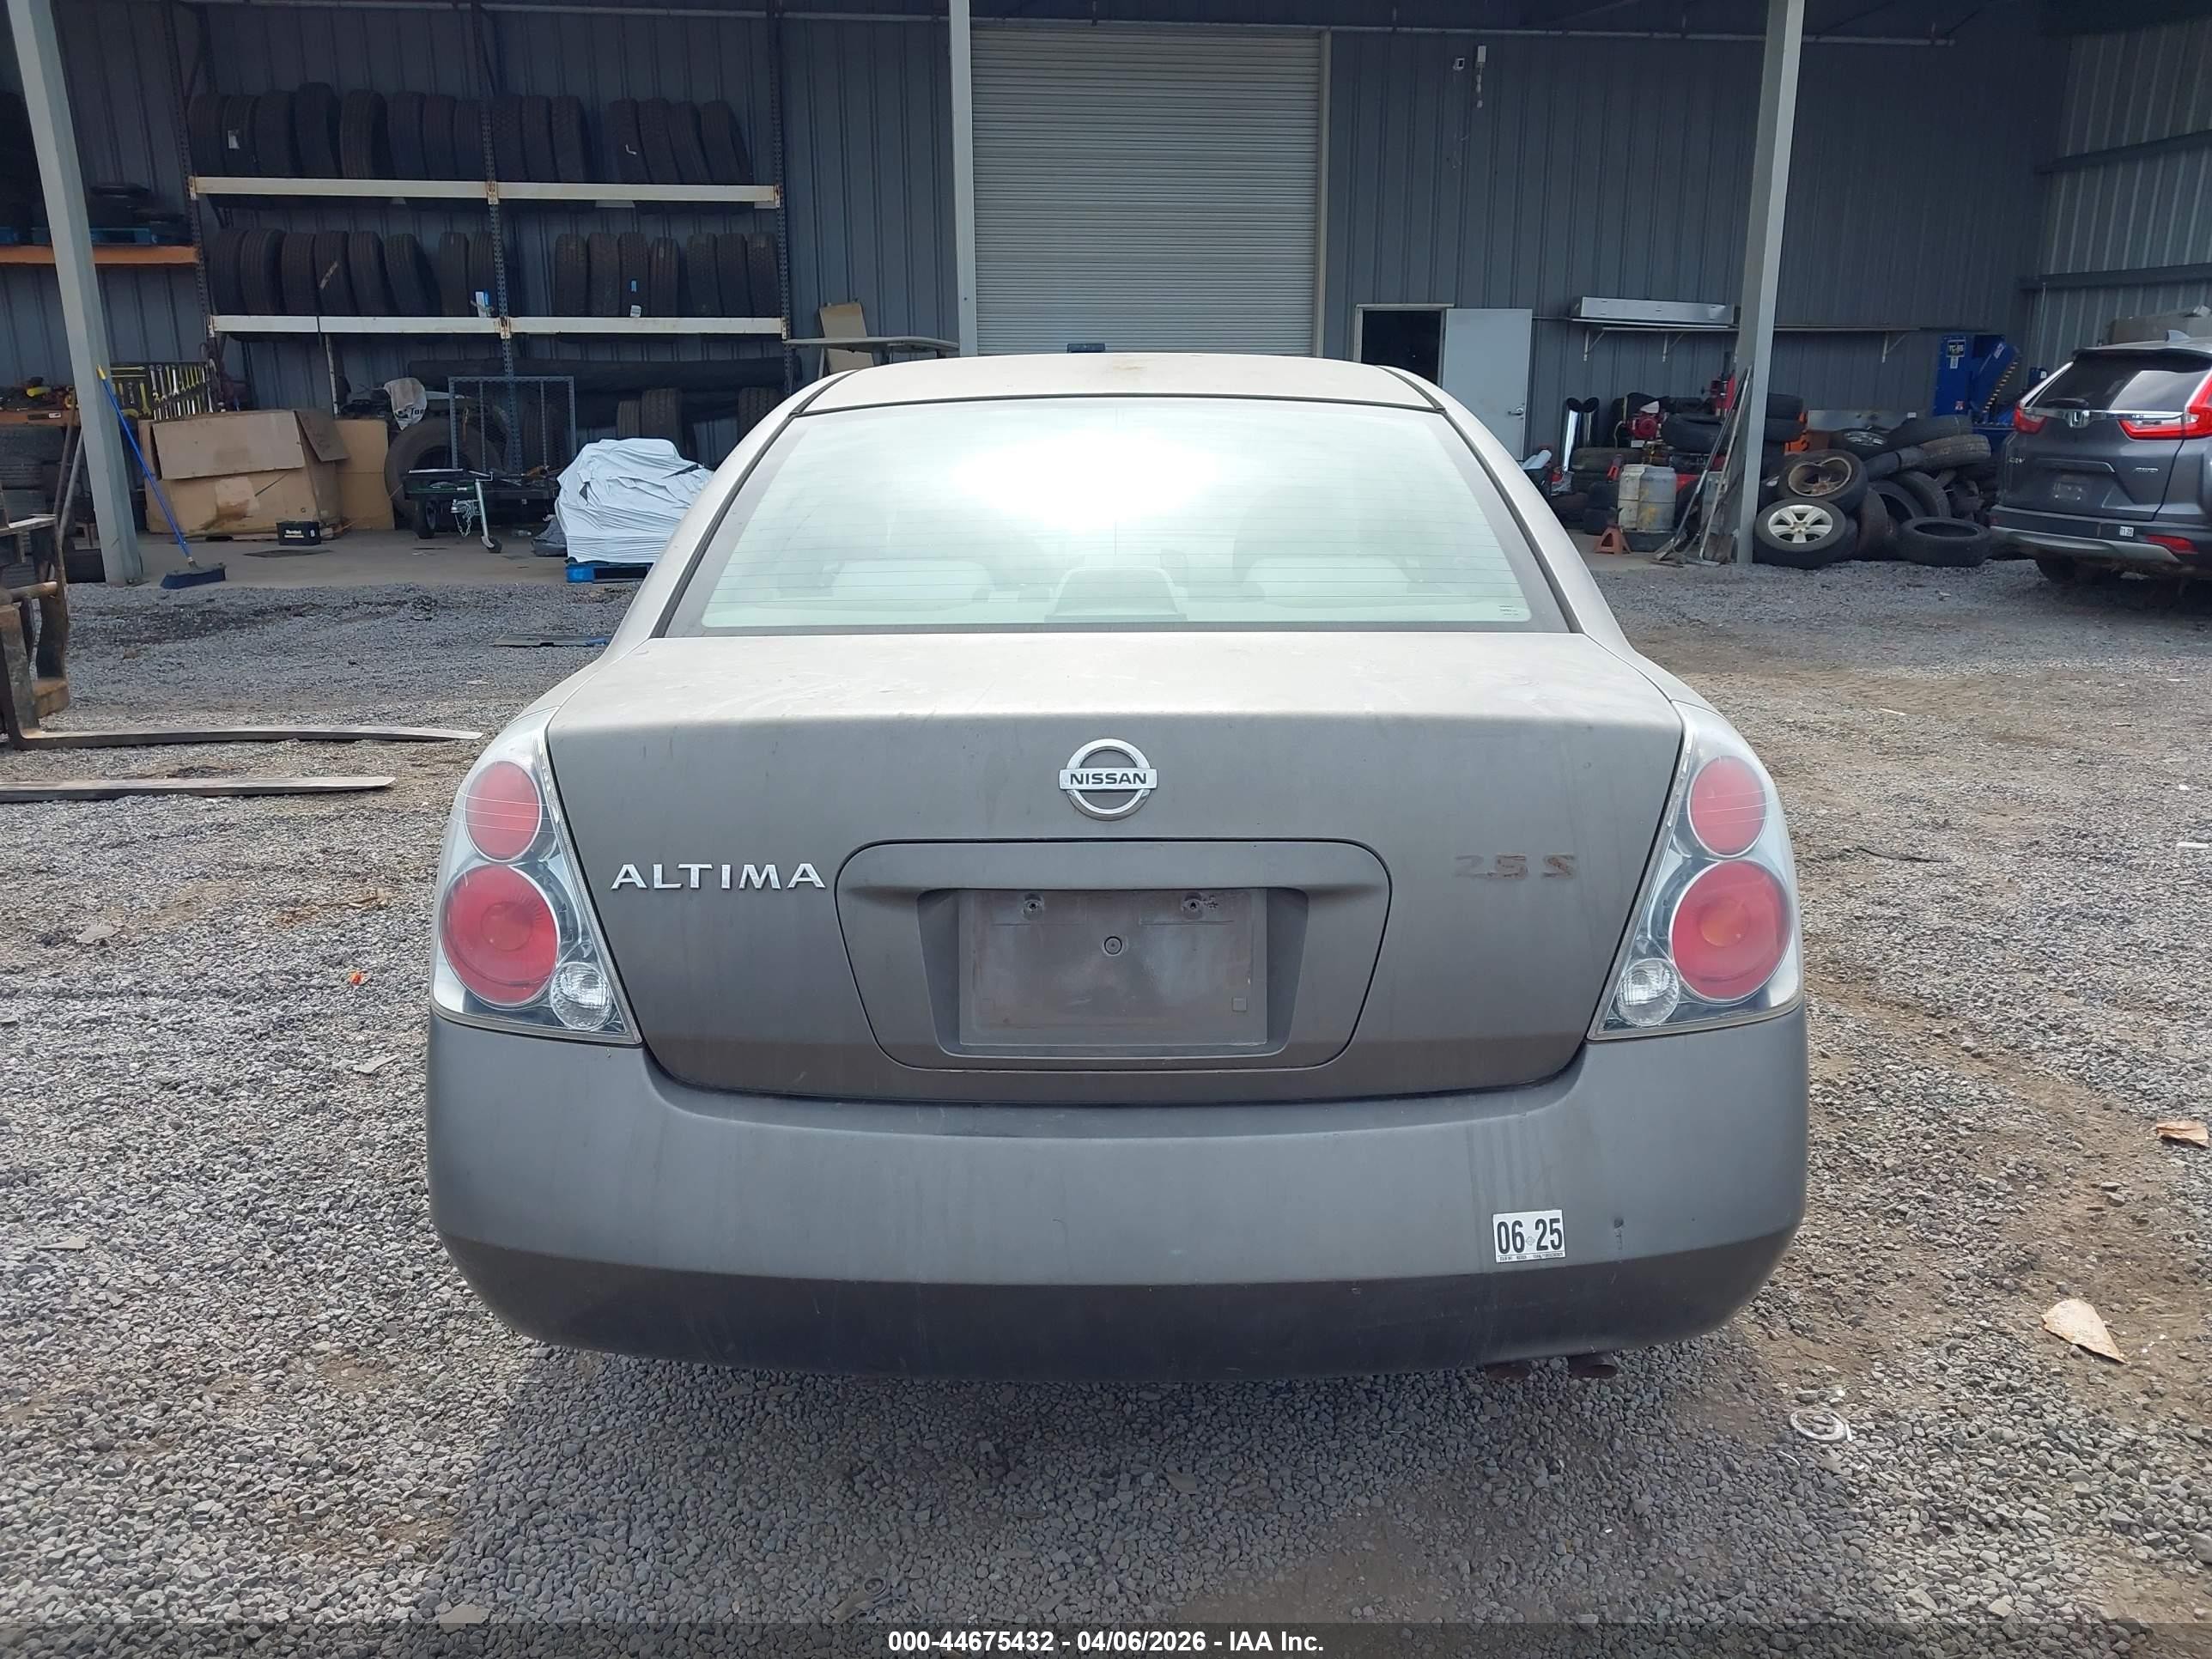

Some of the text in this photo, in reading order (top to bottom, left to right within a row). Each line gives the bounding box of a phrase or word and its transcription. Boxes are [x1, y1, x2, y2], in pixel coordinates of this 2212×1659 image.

[1070, 773, 1147, 785] NISSAN
[610, 862, 827, 890] ALTIMA
[1540, 854, 1575, 879] S
[1497, 1218, 1563, 1255] 06 25
